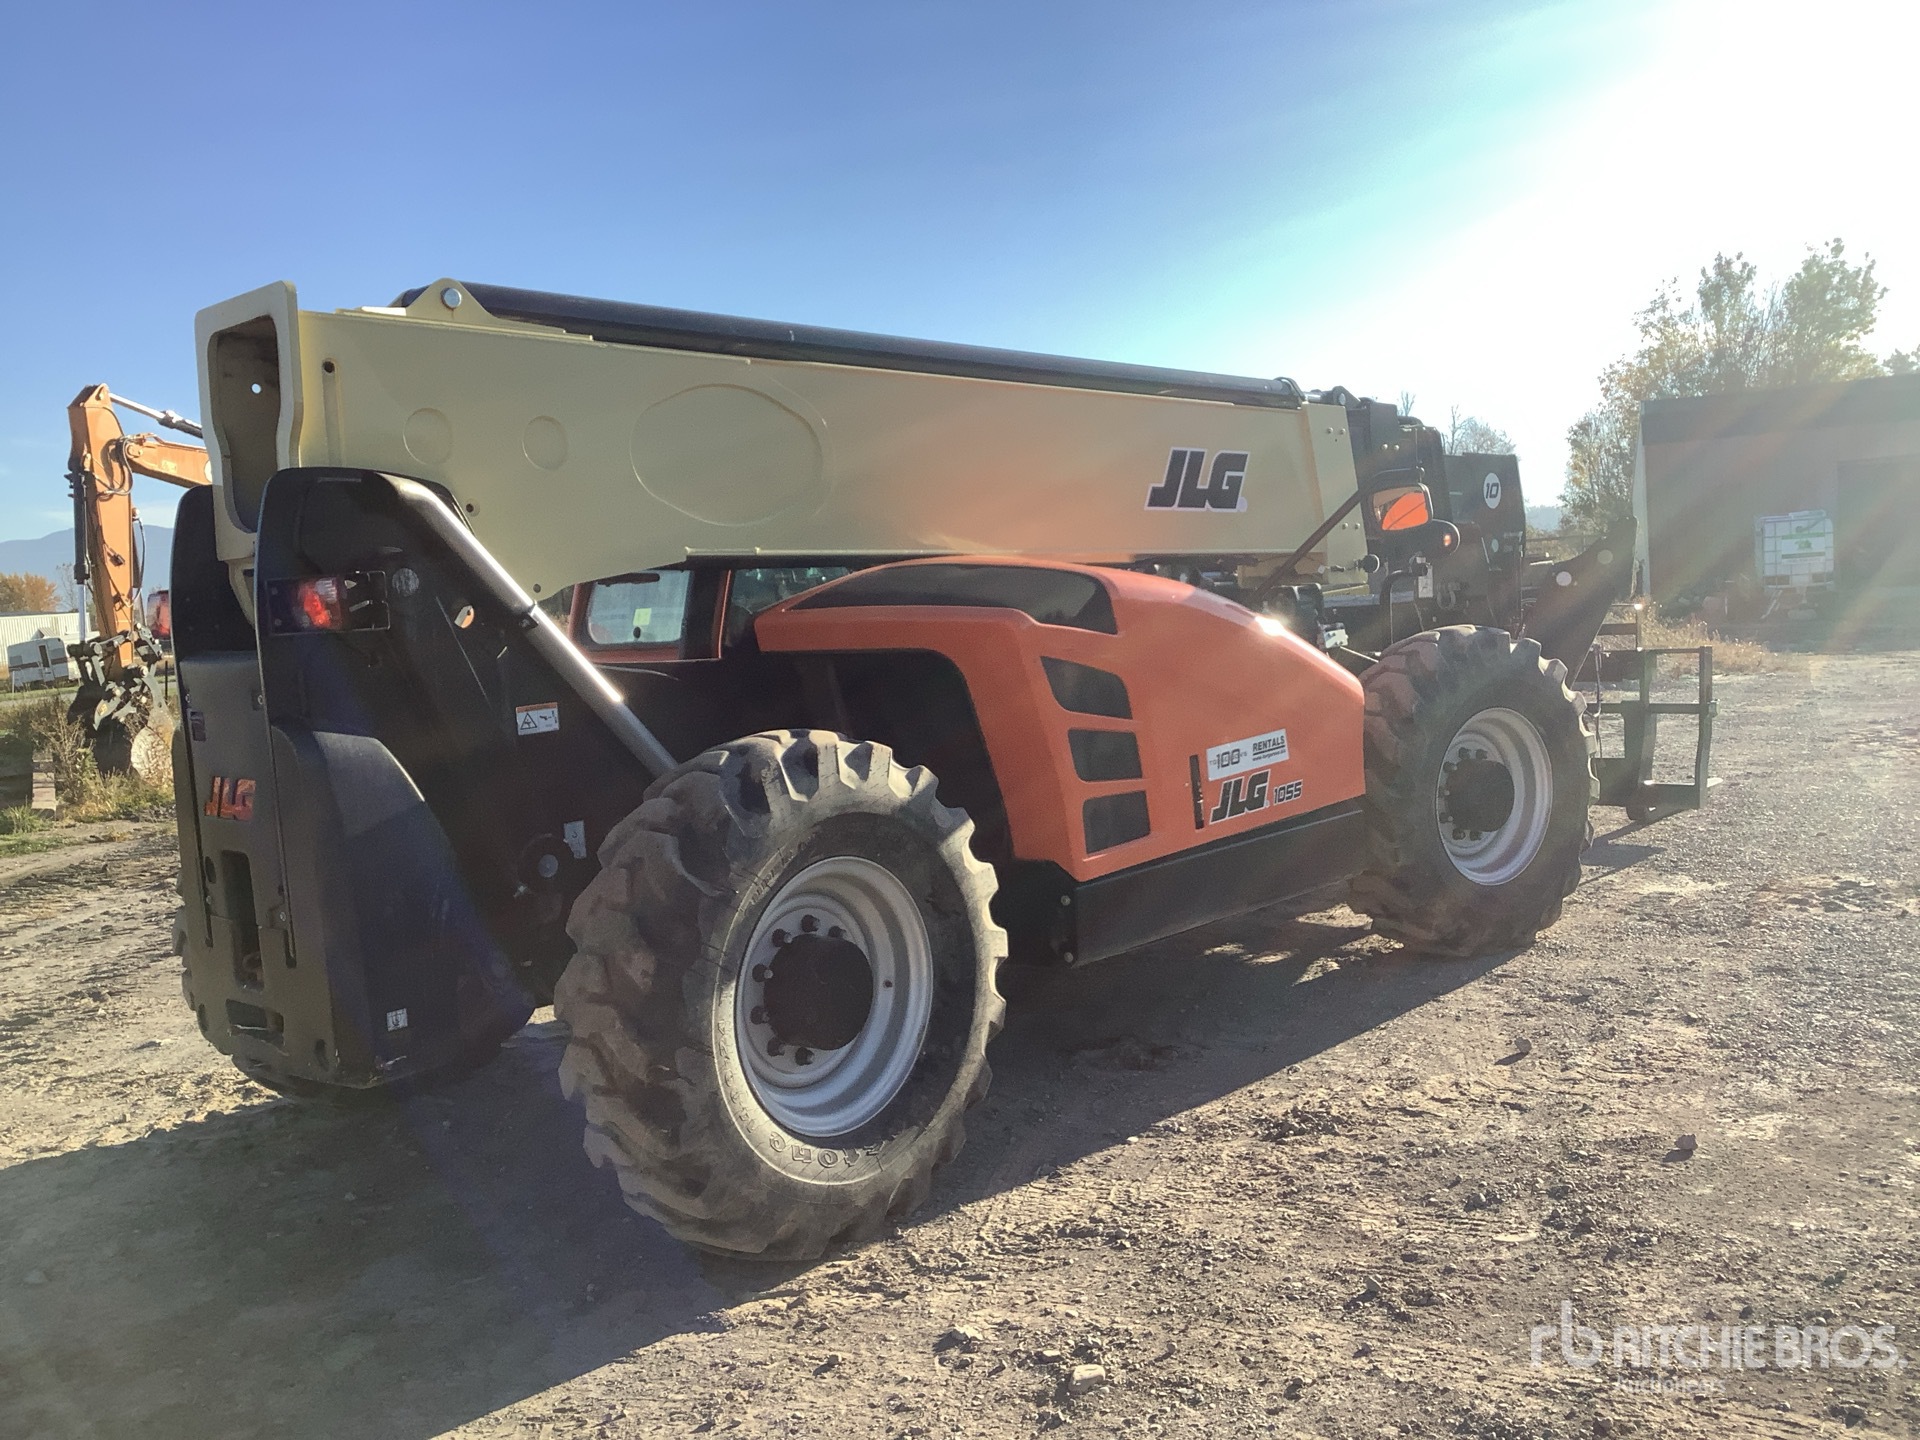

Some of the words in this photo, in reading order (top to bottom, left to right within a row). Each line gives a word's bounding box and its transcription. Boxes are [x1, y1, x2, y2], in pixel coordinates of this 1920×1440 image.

[1145, 448, 1248, 511] JLG
[1485, 482, 1500, 499] 10
[1252, 735, 1286, 752] RENTALS
[204, 775, 256, 821] JLG
[1210, 769, 1270, 824] JLG
[1273, 780, 1303, 805] 1055
